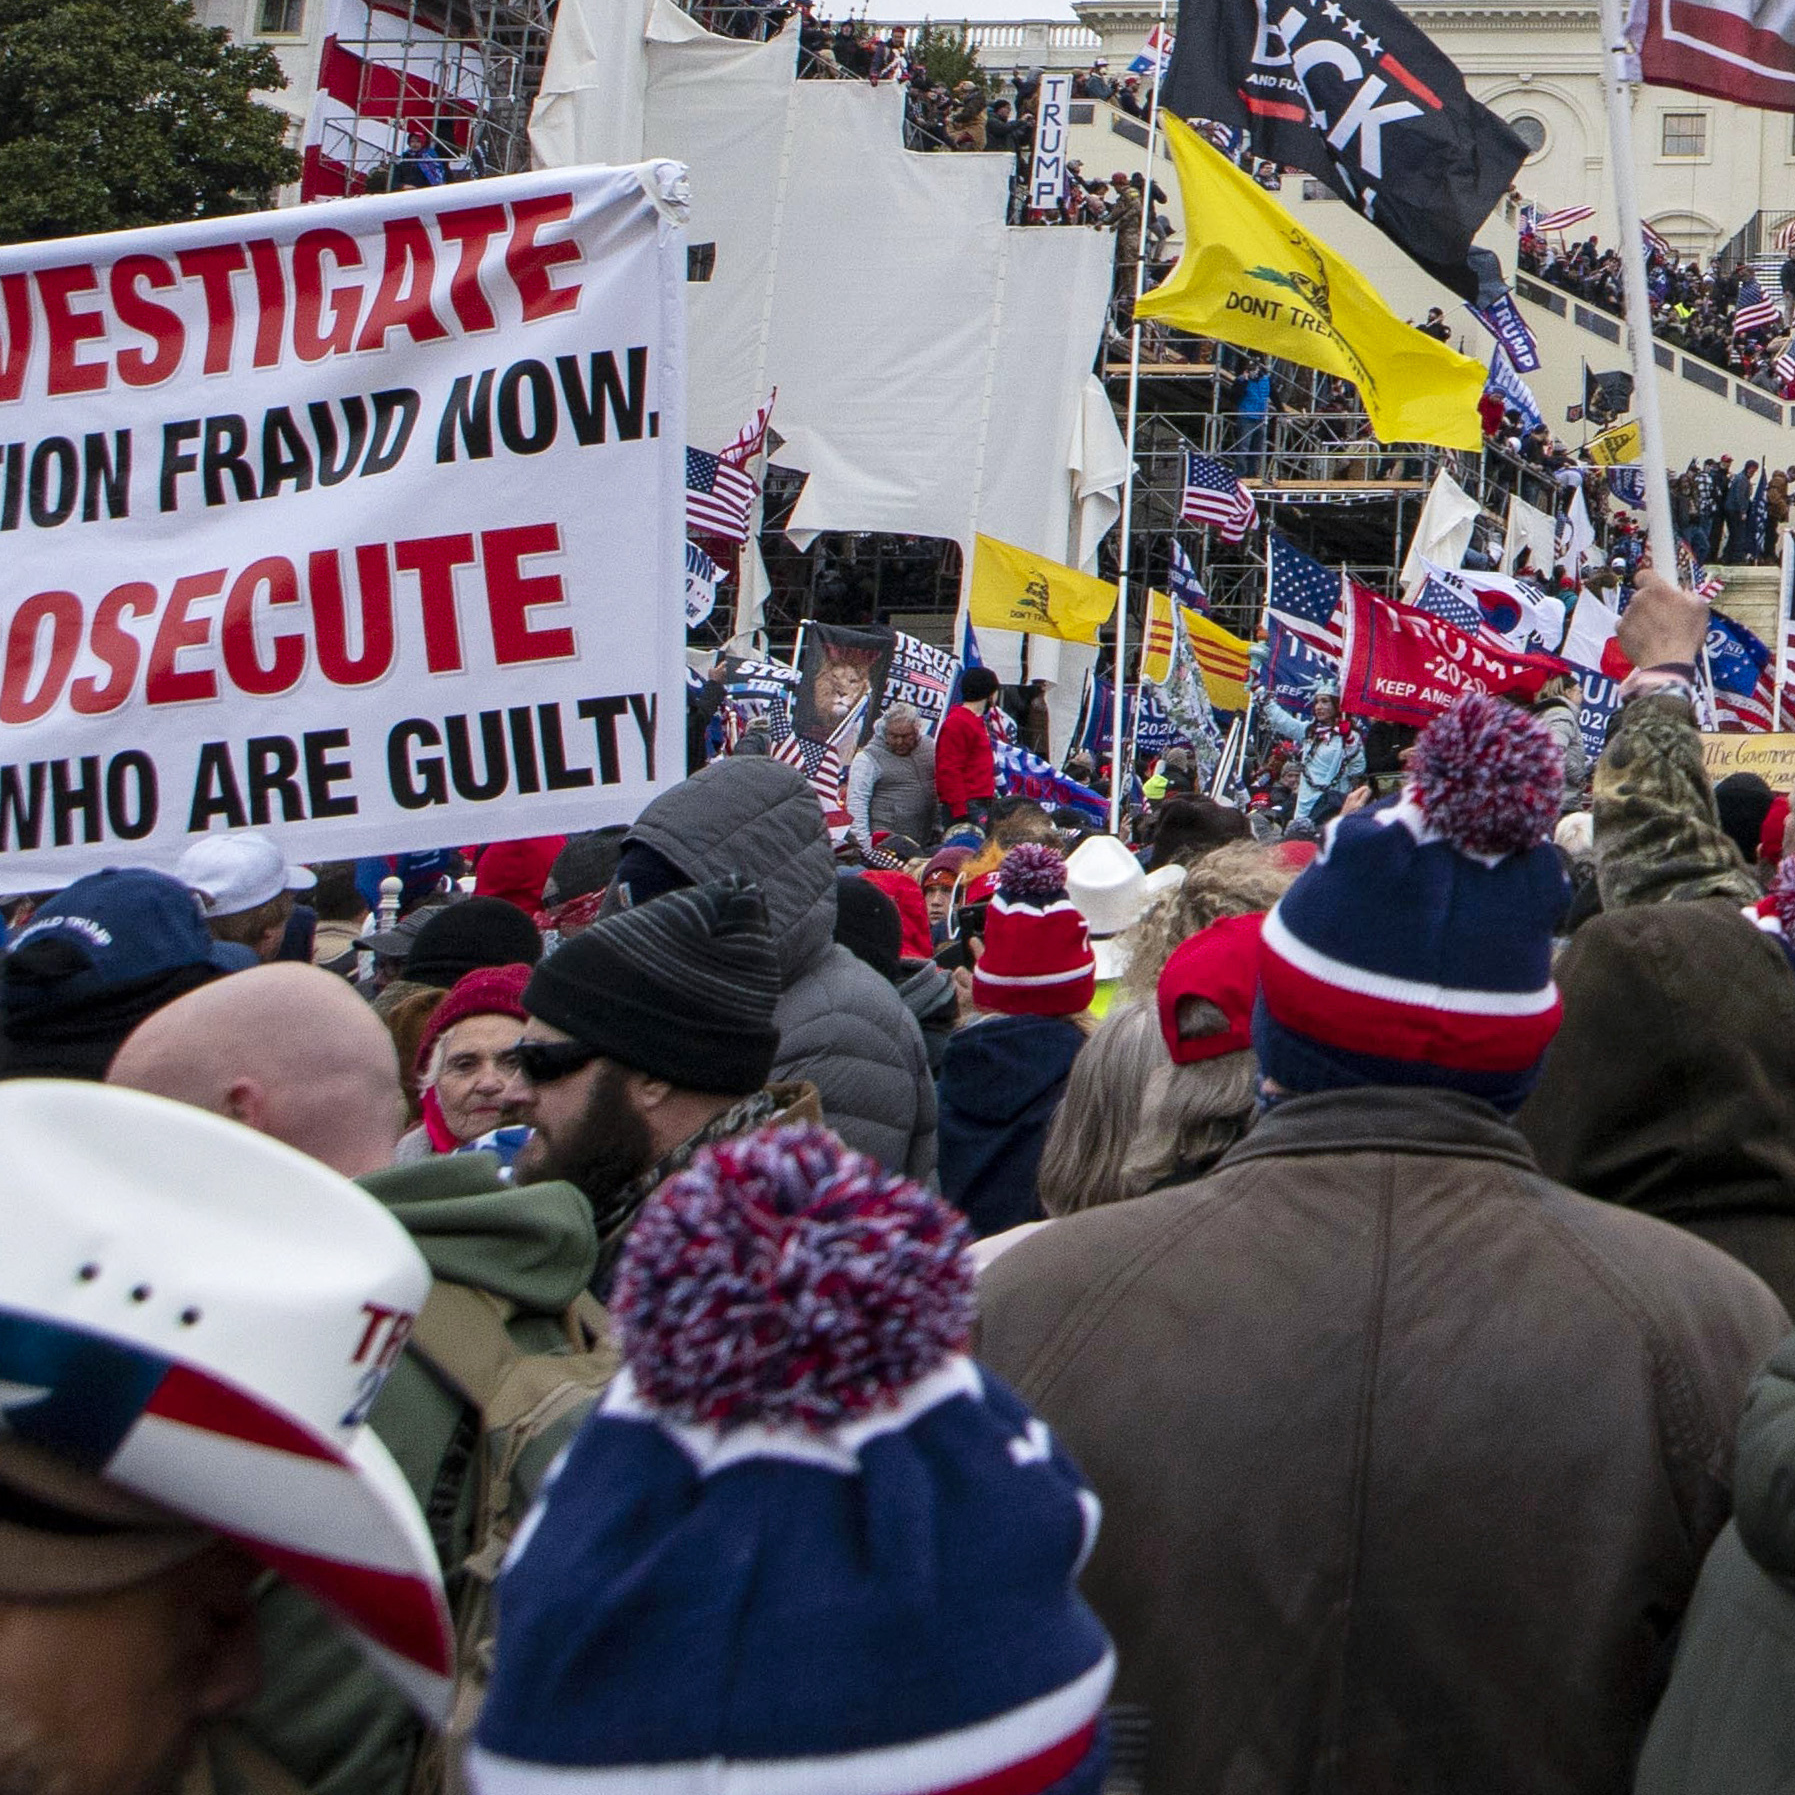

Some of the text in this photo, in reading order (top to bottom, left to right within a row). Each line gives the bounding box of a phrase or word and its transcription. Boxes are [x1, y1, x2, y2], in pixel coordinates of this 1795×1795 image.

[1246, 72, 1306, 96] AND FUC
[1036, 80, 1064, 206] TRUMP
[1226, 292, 1283, 325] DONT
[1490, 296, 1535, 371] TRUMP
[0, 347, 660, 531] ION FRAUD NOW.
[0, 523, 578, 725] OSECUTE
[894, 630, 966, 671] JESUS
[1707, 630, 1744, 659] 2ND
[1275, 684, 1301, 696] KEEP
[1375, 677, 1417, 698] KEEP
[1138, 720, 1176, 736] 2020
[0, 692, 658, 852] WHO ARE GUILTY
[66, 916, 113, 946] TRUMP
